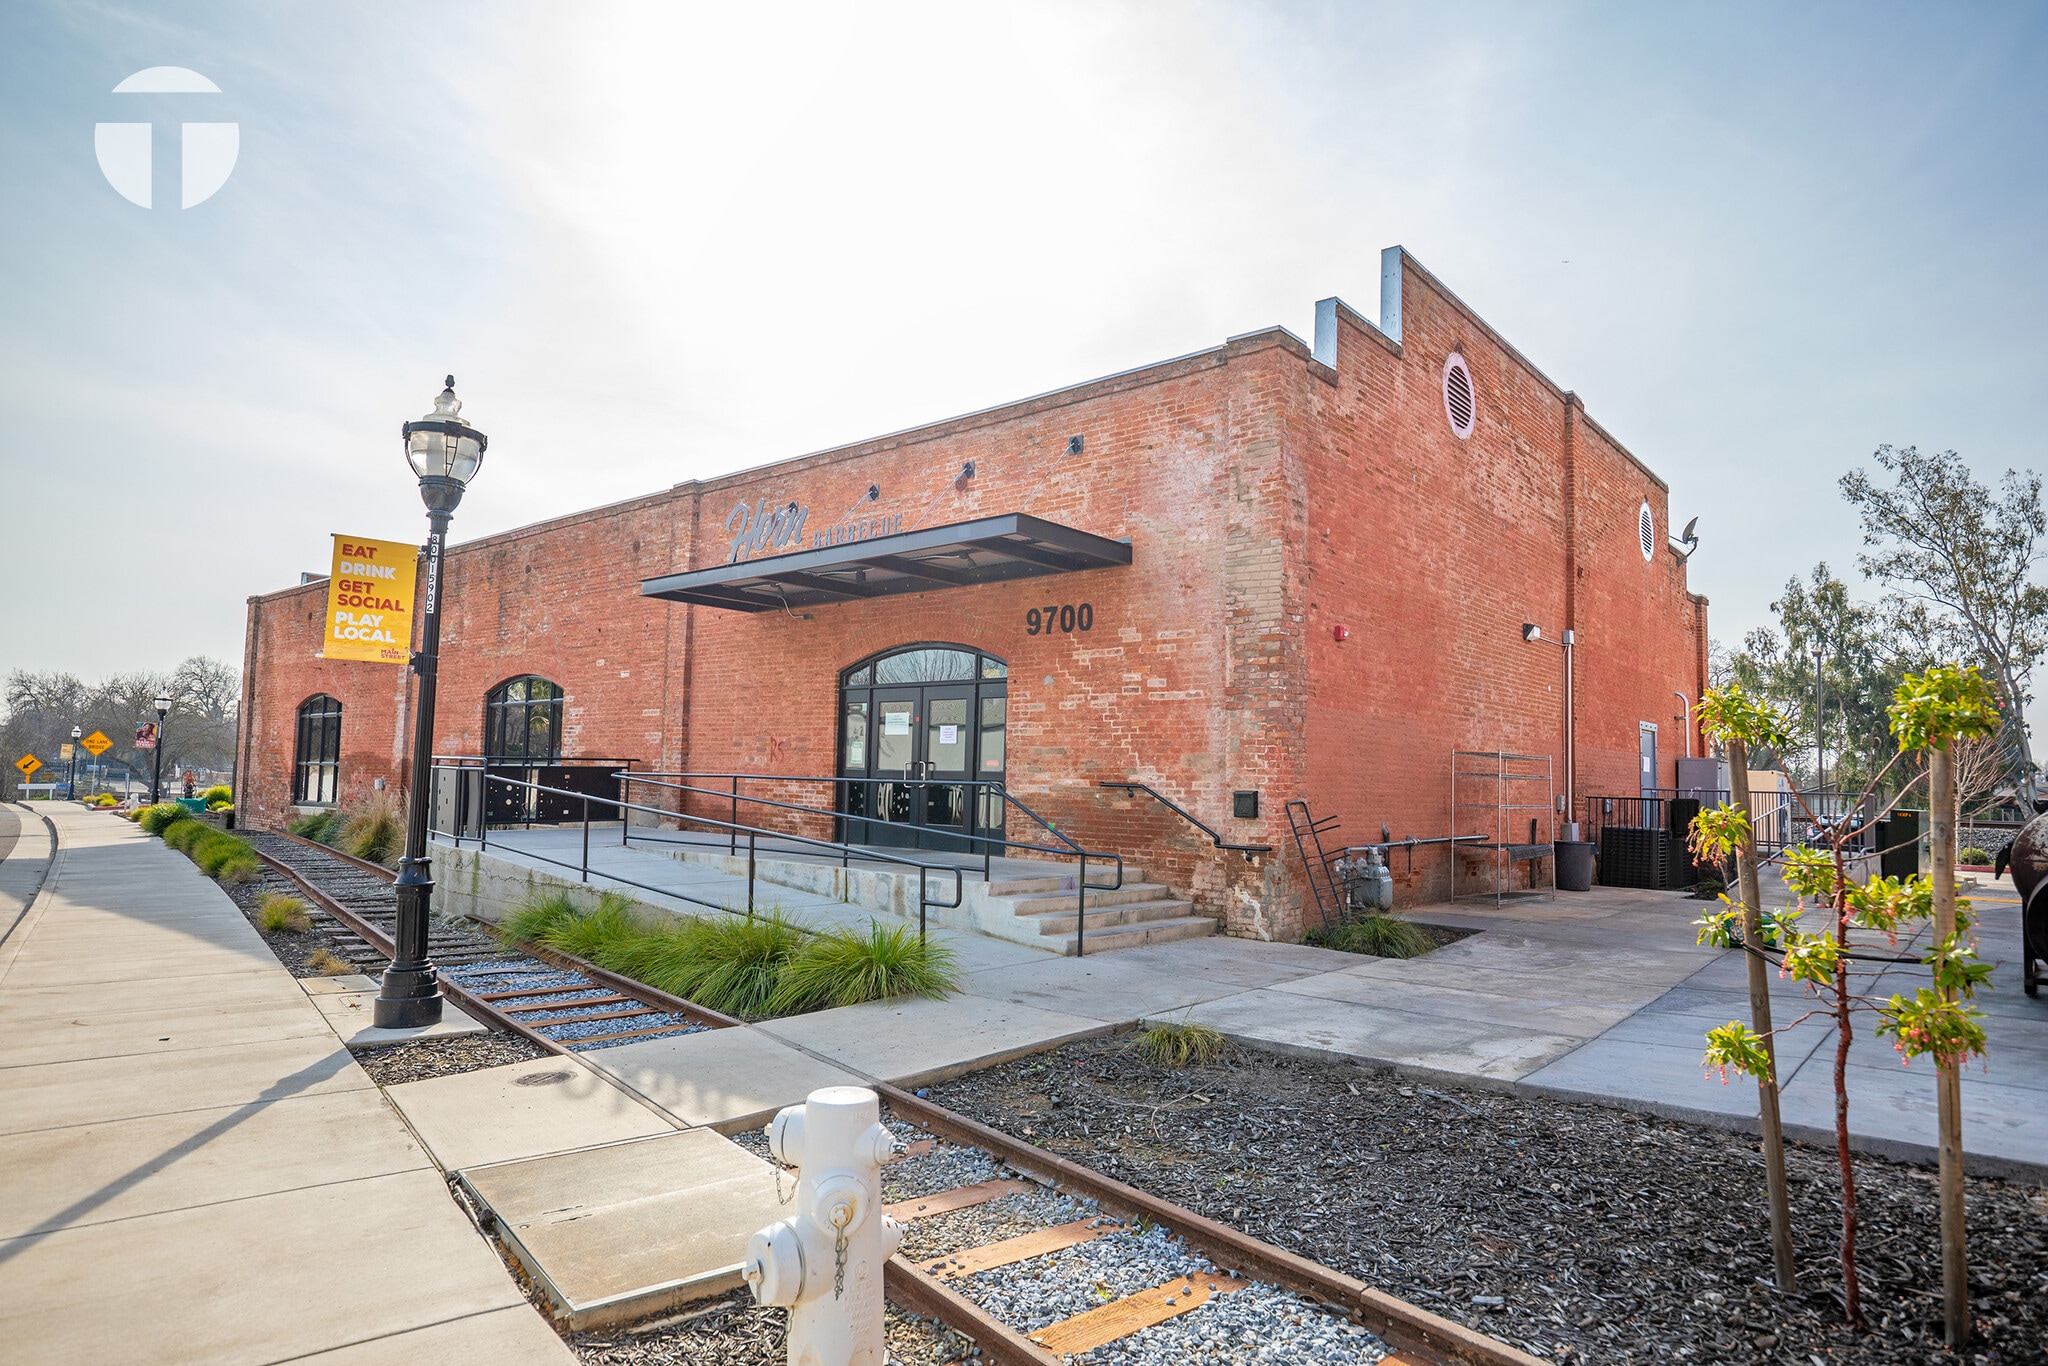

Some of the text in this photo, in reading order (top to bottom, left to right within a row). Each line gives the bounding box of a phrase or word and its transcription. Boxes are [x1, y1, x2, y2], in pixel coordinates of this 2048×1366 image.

[725, 498, 903, 562] Horn BARBECUE
[342, 543, 377, 559] EAT
[340, 561, 397, 580] DRINK
[426, 535, 439, 612] 80015902
[338, 579, 375, 594] GET
[337, 594, 405, 612] SOCIAL
[335, 611, 384, 627] PLAY
[1026, 603, 1093, 635] 9700
[333, 626, 396, 643] LOCAL
